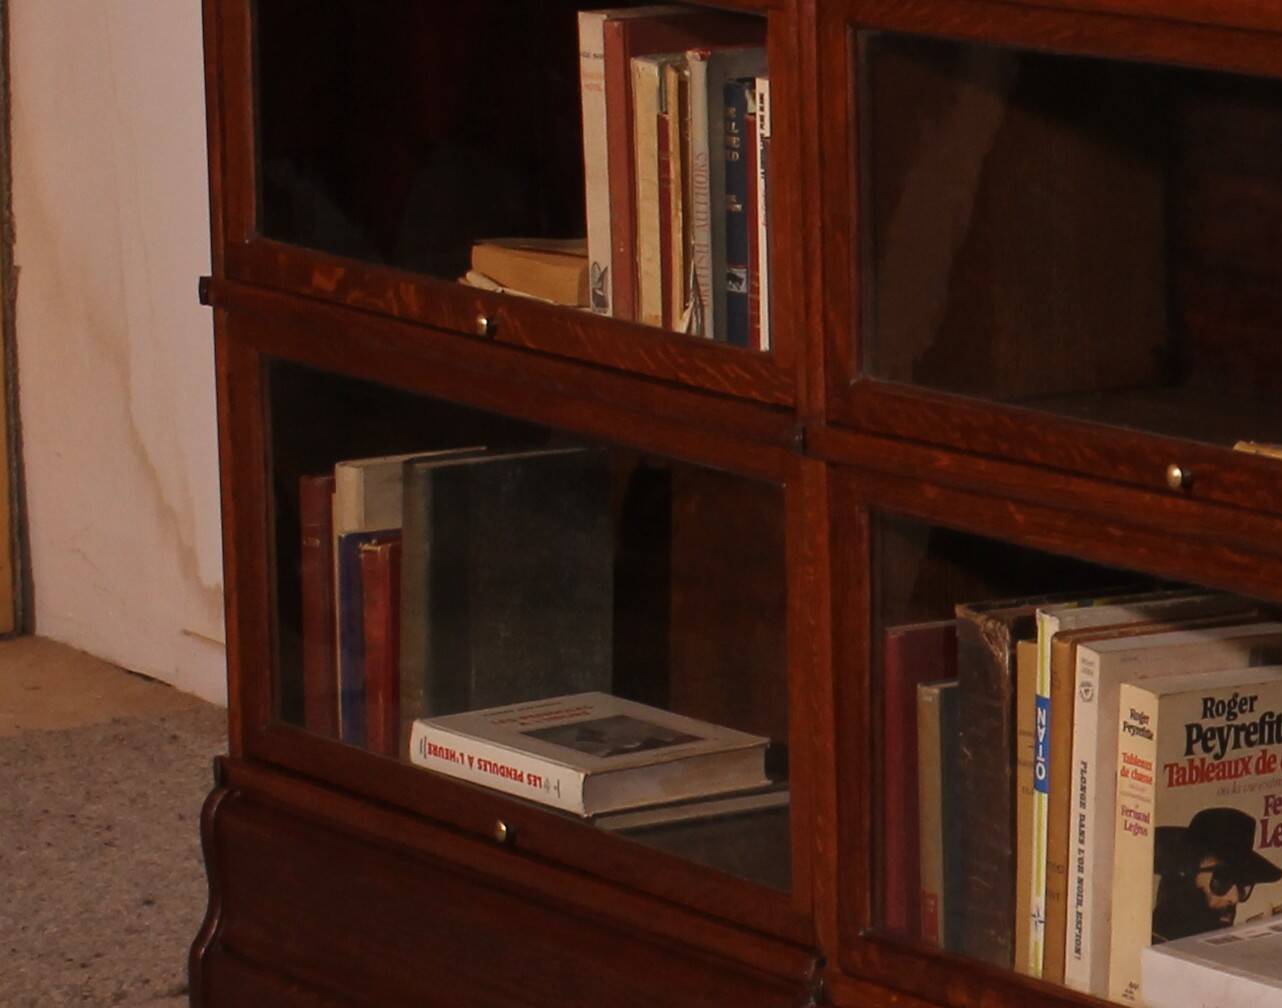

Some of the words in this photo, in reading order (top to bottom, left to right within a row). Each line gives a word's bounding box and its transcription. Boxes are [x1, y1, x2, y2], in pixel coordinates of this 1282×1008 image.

[694, 151, 709, 231] AUTHORS
[1130, 708, 1149, 725] Roger
[1201, 692, 1258, 721] Roger
[477, 757, 524, 782] PENDULES
[528, 771, 543, 790] LES
[1120, 765, 1130, 778] de
[1164, 753, 1253, 788] Tableaux
[1254, 748, 1277, 776] de
[1079, 760, 1088, 810] PLONGE
[1121, 804, 1150, 824] Fernand
[1078, 813, 1086, 846] DANS
